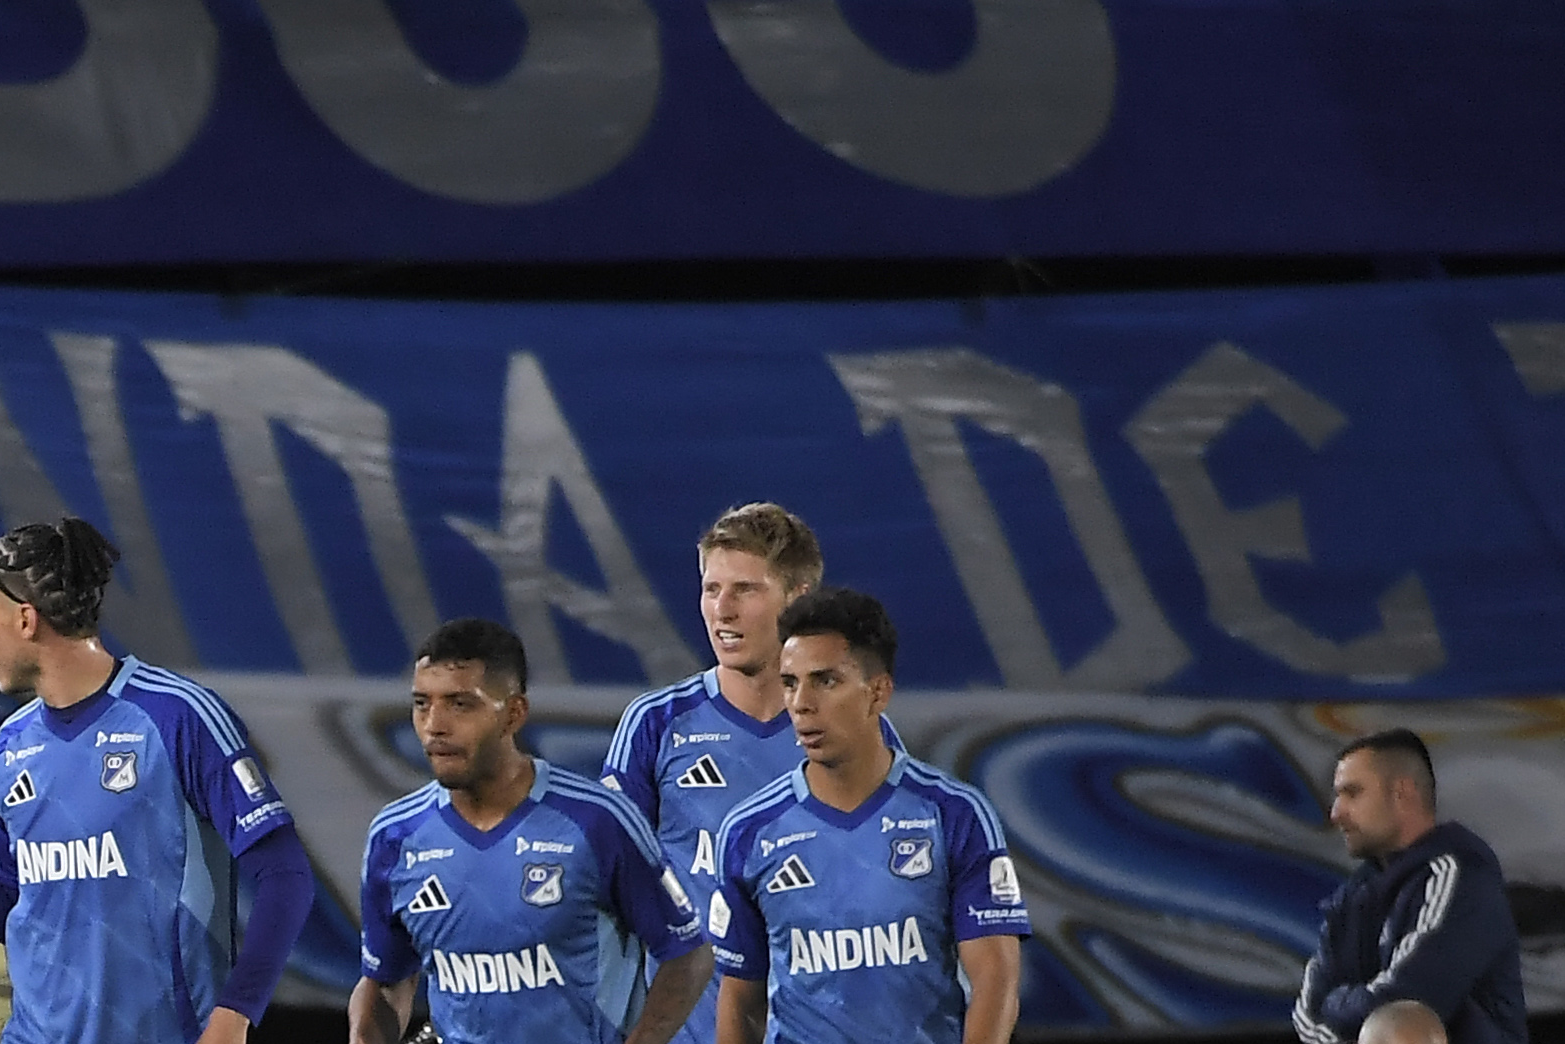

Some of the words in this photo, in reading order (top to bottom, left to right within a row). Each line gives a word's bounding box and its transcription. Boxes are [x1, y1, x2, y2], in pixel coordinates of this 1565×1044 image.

[826, 340, 1448, 692] DE
[16, 830, 128, 885] ANDINA
[433, 943, 565, 994] ANDINA
[789, 916, 928, 976] ANDINA
